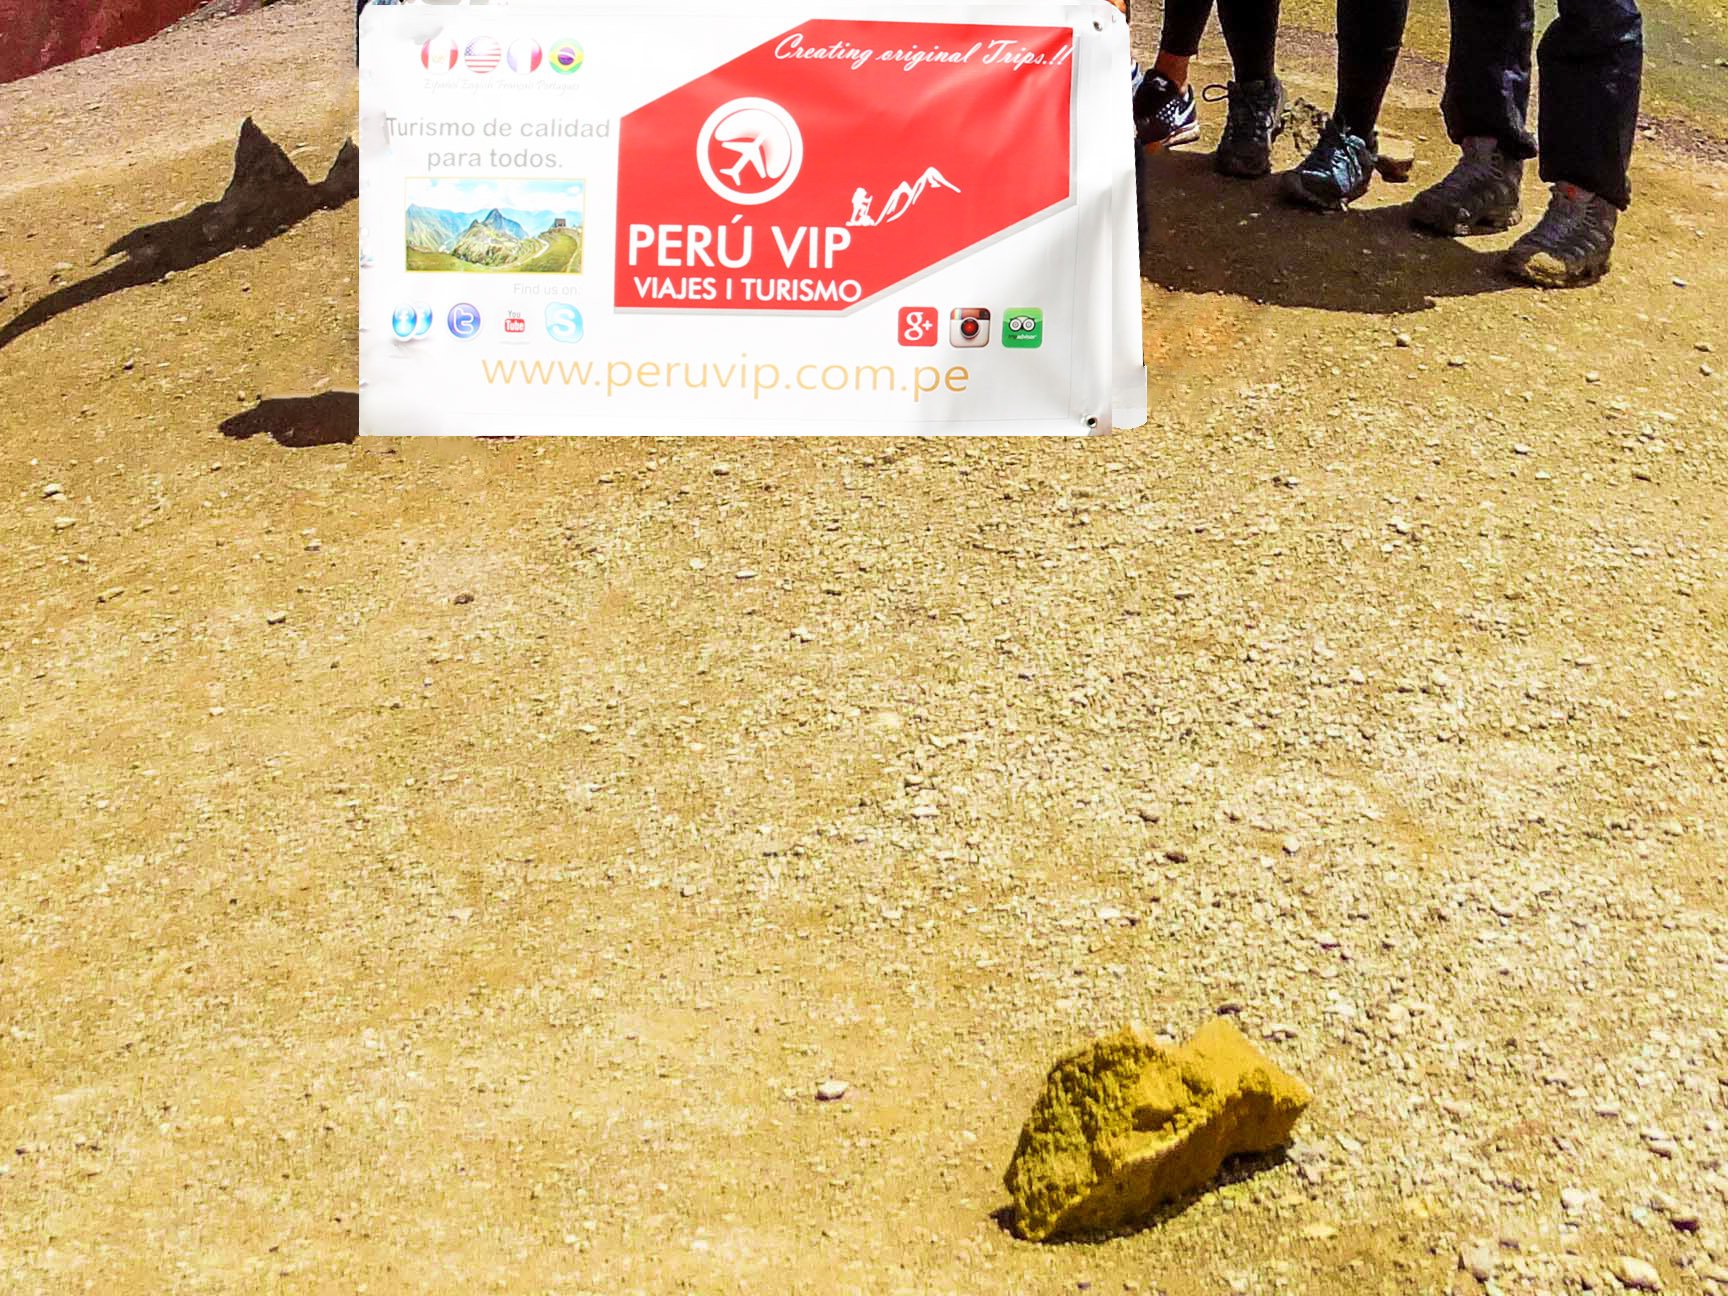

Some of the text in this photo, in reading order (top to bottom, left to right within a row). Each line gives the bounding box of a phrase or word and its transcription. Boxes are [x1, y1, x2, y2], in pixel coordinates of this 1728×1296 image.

[774, 32, 873, 71] Creating
[875, 41, 983, 72] original
[385, 116, 611, 139] Turismo de calidad
[426, 148, 564, 172] para todos.
[628, 214, 851, 269] PERÚ VIP
[512, 282, 540, 295] Find
[633, 276, 717, 300] VIAJES
[740, 278, 863, 303] TURISMO
[507, 309, 522, 319] You
[481, 353, 970, 403] www.peruvip.com.pe
